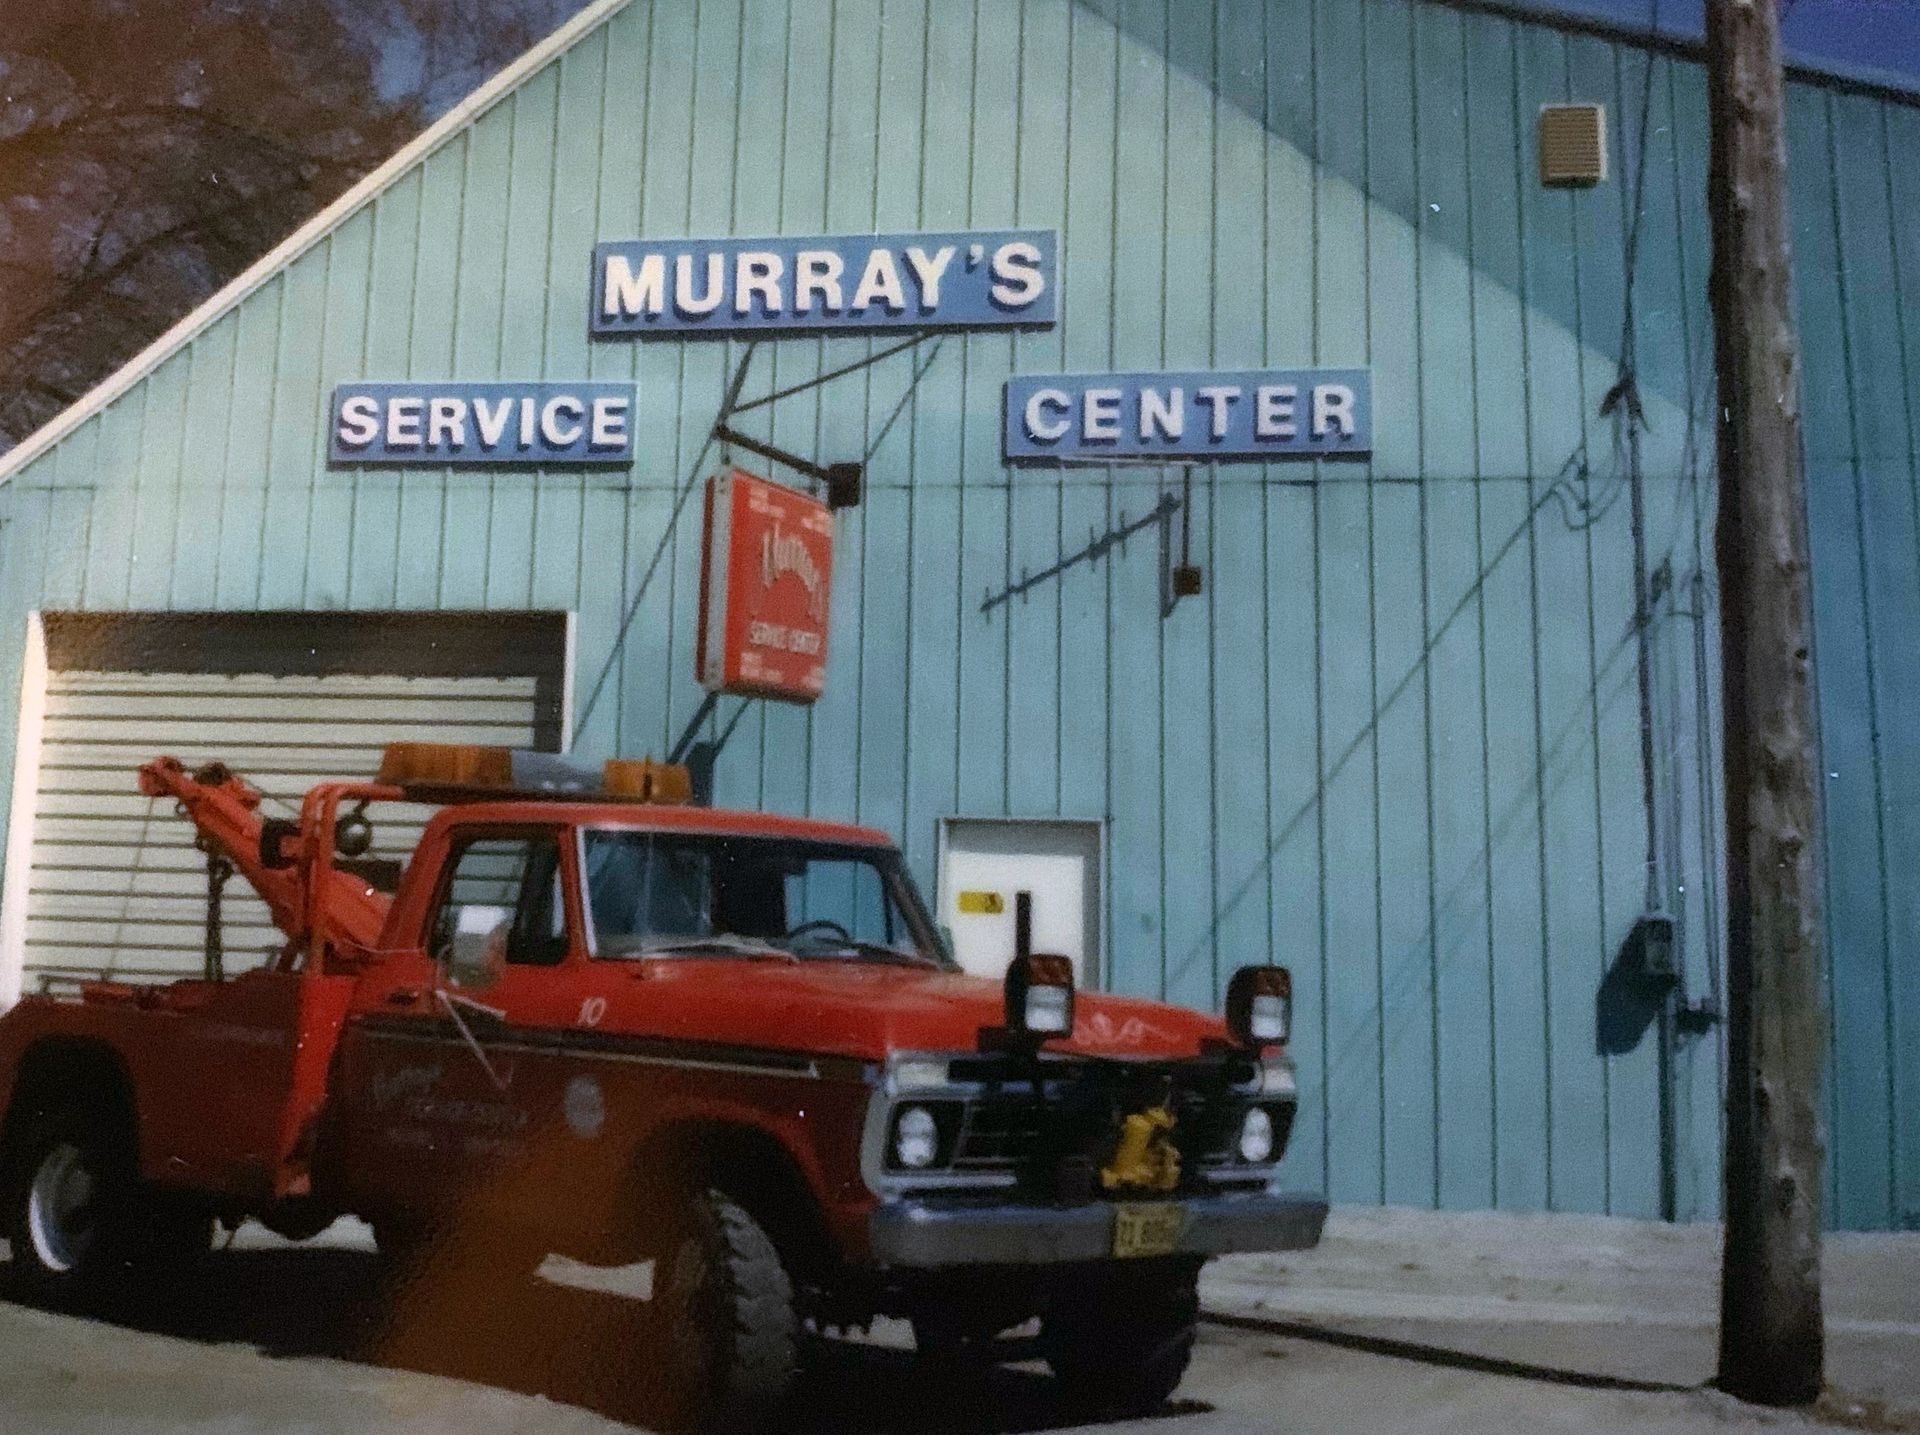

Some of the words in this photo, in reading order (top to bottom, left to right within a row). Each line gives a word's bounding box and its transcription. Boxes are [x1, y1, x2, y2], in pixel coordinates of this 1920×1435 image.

[604, 242, 1045, 315] MURRAY'S
[339, 395, 630, 446] SERVICE
[1025, 384, 1355, 440] CENTER
